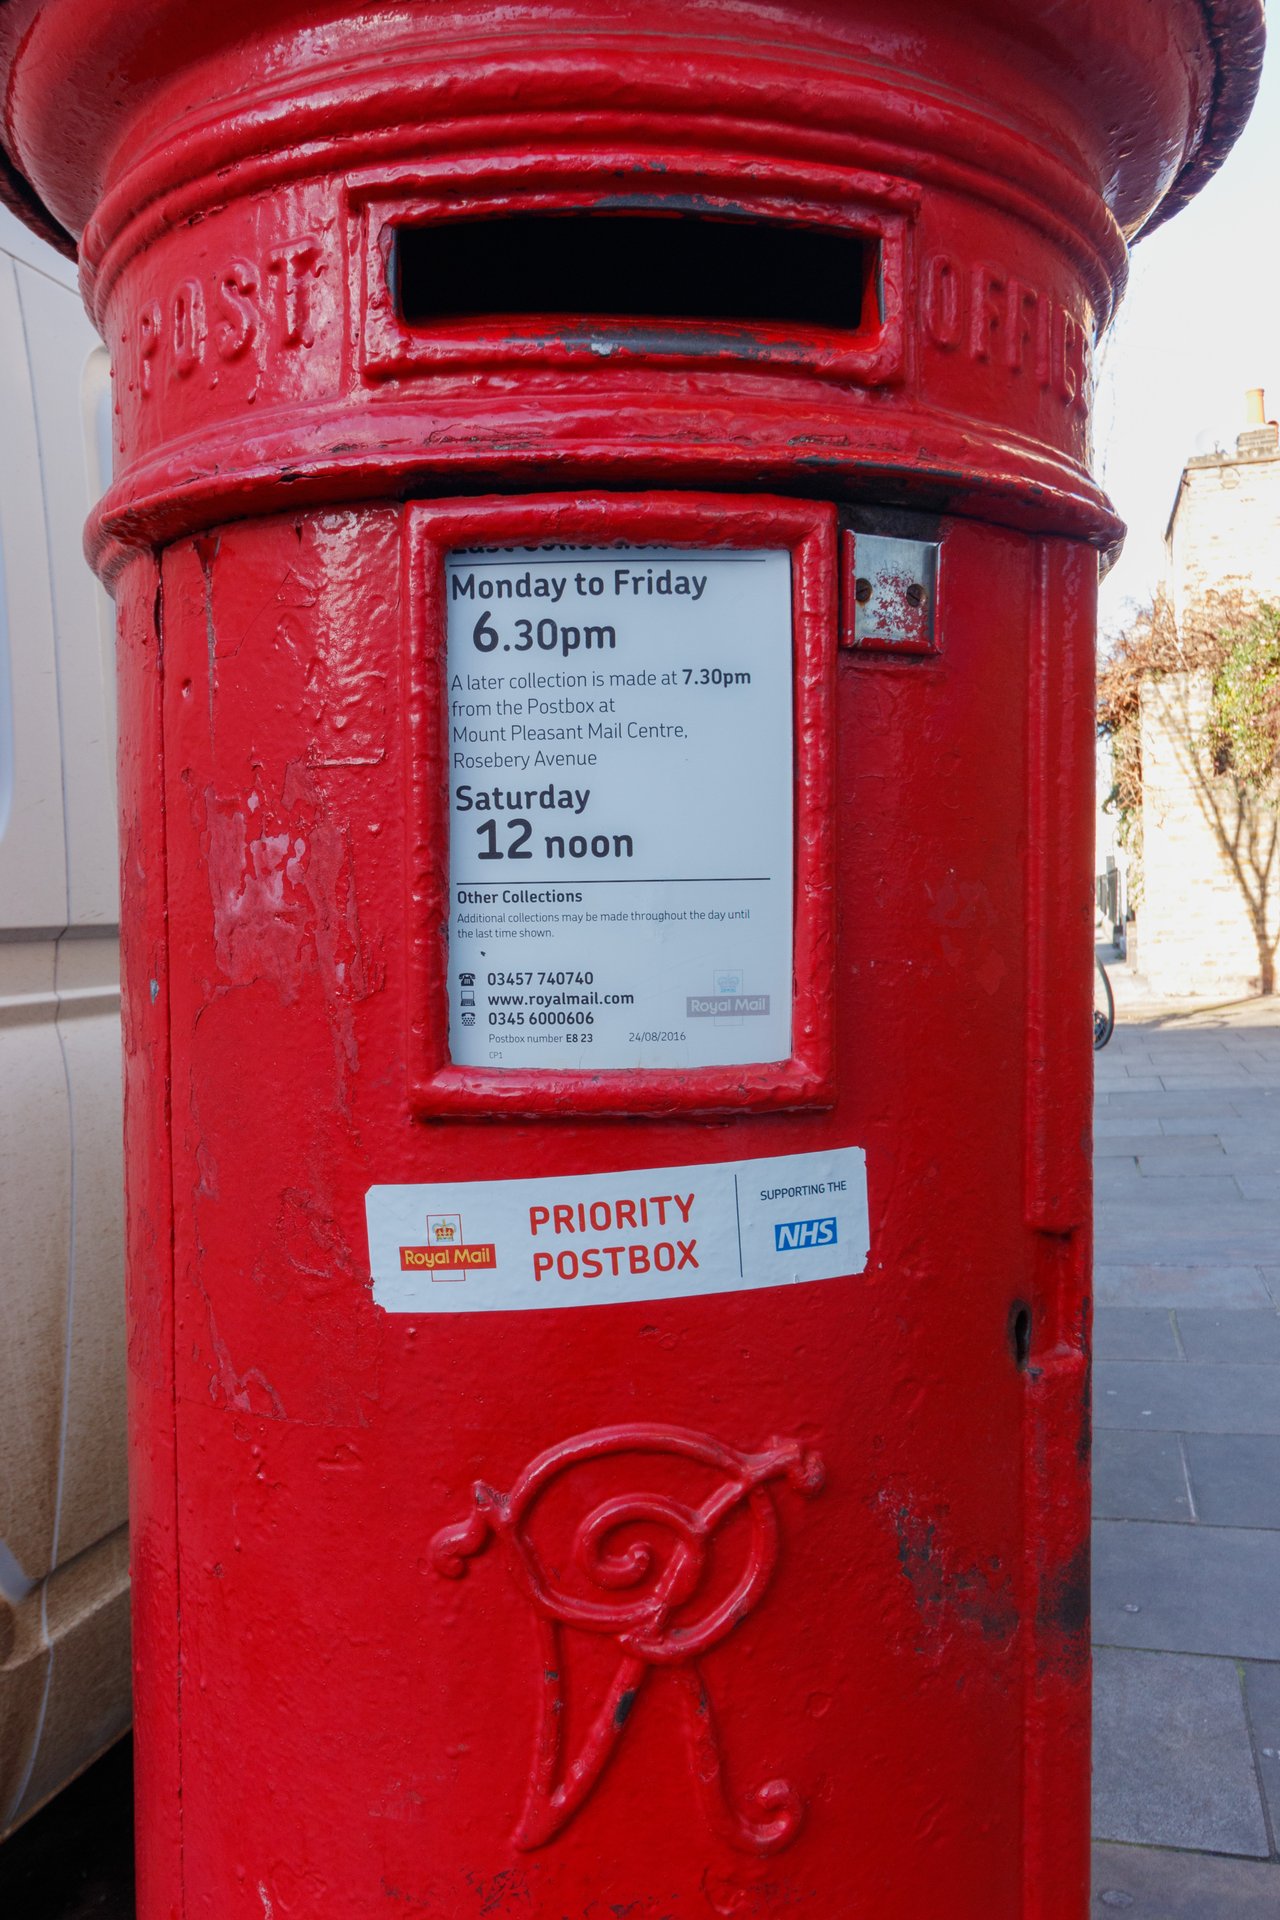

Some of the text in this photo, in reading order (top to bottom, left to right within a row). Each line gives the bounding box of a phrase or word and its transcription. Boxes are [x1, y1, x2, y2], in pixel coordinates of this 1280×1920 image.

[137, 234, 324, 398] POST
[451, 568, 708, 602] Monday to Friday
[472, 610, 617, 657] 6.30pm
[451, 668, 751, 691] A later collection is made at 7.30pm
[452, 697, 616, 717] from the Postbox at
[453, 721, 688, 742] Mount Pleasant Mail Centre,
[454, 750, 597, 770] Rosebery Avenue
[455, 784, 591, 814] Saturday
[476, 818, 634, 860] 12 noon
[457, 889, 583, 904] Other Collections
[457, 909, 751, 924] Additional collections may be made throughout the day until
[457, 928, 554, 939] the last time shown.
[487, 971, 594, 986] 03457 740740
[488, 991, 634, 1008] www.royalmail.com
[691, 997, 766, 1014] Royal Mail
[488, 1011, 594, 1025] 0345 6000606
[488, 1033, 593, 1043] Postbox number E8 23
[628, 1031, 687, 1043] 24/08/2016
[488, 1051, 503, 1060] CP1
[760, 1180, 847, 1201] SUPPORTING THE
[529, 1193, 696, 1236] PRIORITY
[777, 1219, 834, 1250] NHS
[404, 1247, 490, 1267] Royal Mail
[532, 1239, 700, 1282] POSTBOX
